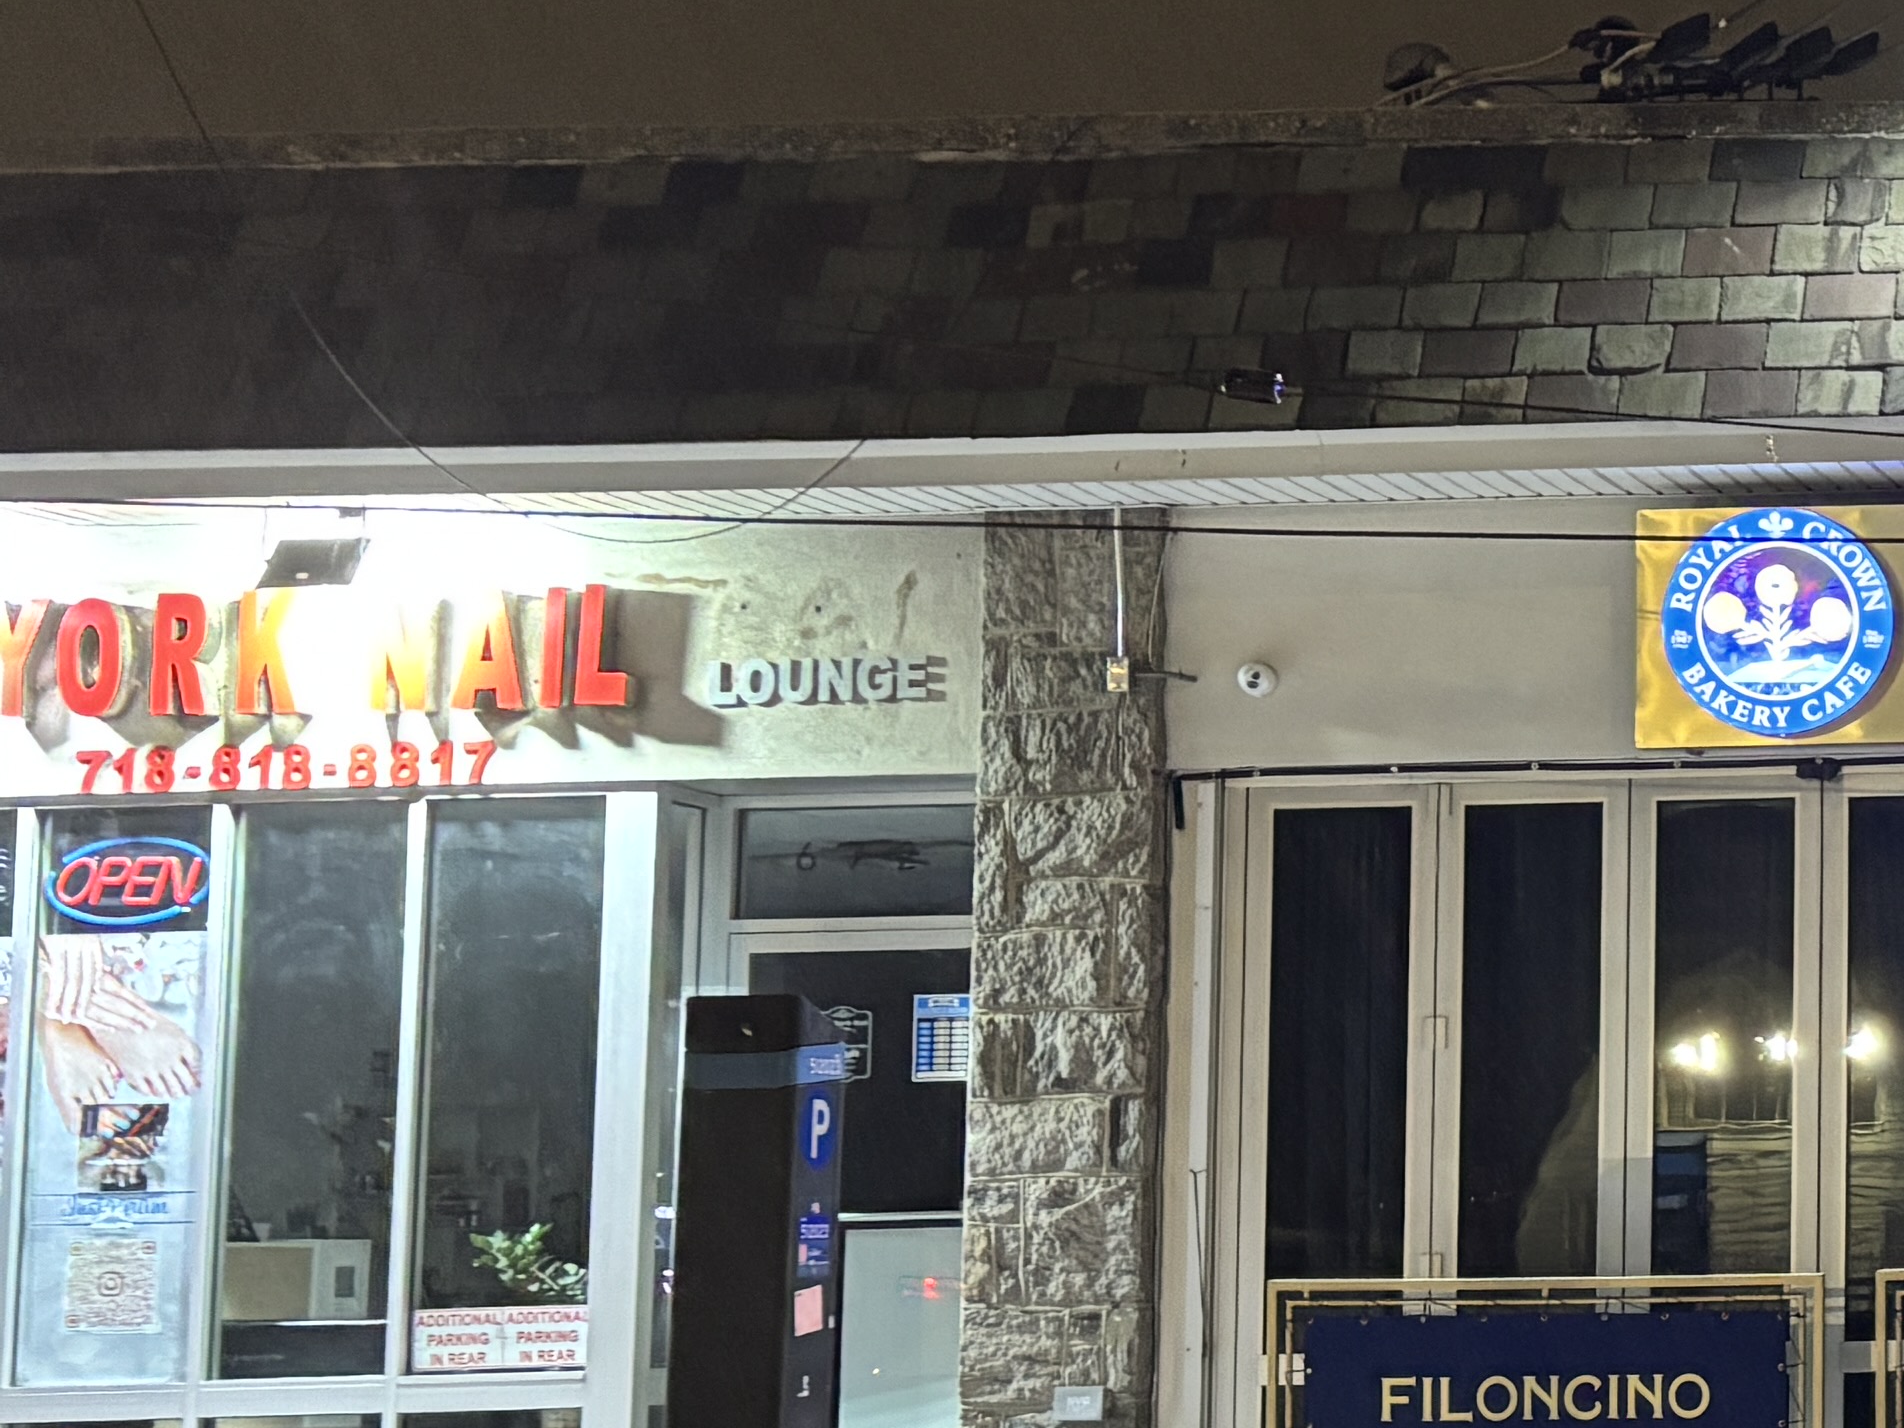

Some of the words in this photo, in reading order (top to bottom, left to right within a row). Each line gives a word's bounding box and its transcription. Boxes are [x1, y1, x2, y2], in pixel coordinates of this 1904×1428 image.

[1802, 521, 1888, 612] CROWN
[0, 590, 297, 717] YORK
[370, 584, 627, 712] NAIL
[708, 657, 928, 705] LOUNGE
[1682, 662, 1791, 728] BAKERY
[1801, 662, 1872, 722] CAFE
[75, 740, 498, 794] 718-818-8817
[57, 856, 202, 906] OPEN
[810, 1098, 831, 1159] P
[427, 1332, 491, 1347] PARKING
[429, 1354, 444, 1366] IN
[448, 1352, 487, 1364] REAR
[516, 1330, 580, 1344] PARKING
[519, 1351, 533, 1363] IN
[537, 1349, 576, 1362] REAR
[1379, 1372, 1711, 1423] FILONCINO
